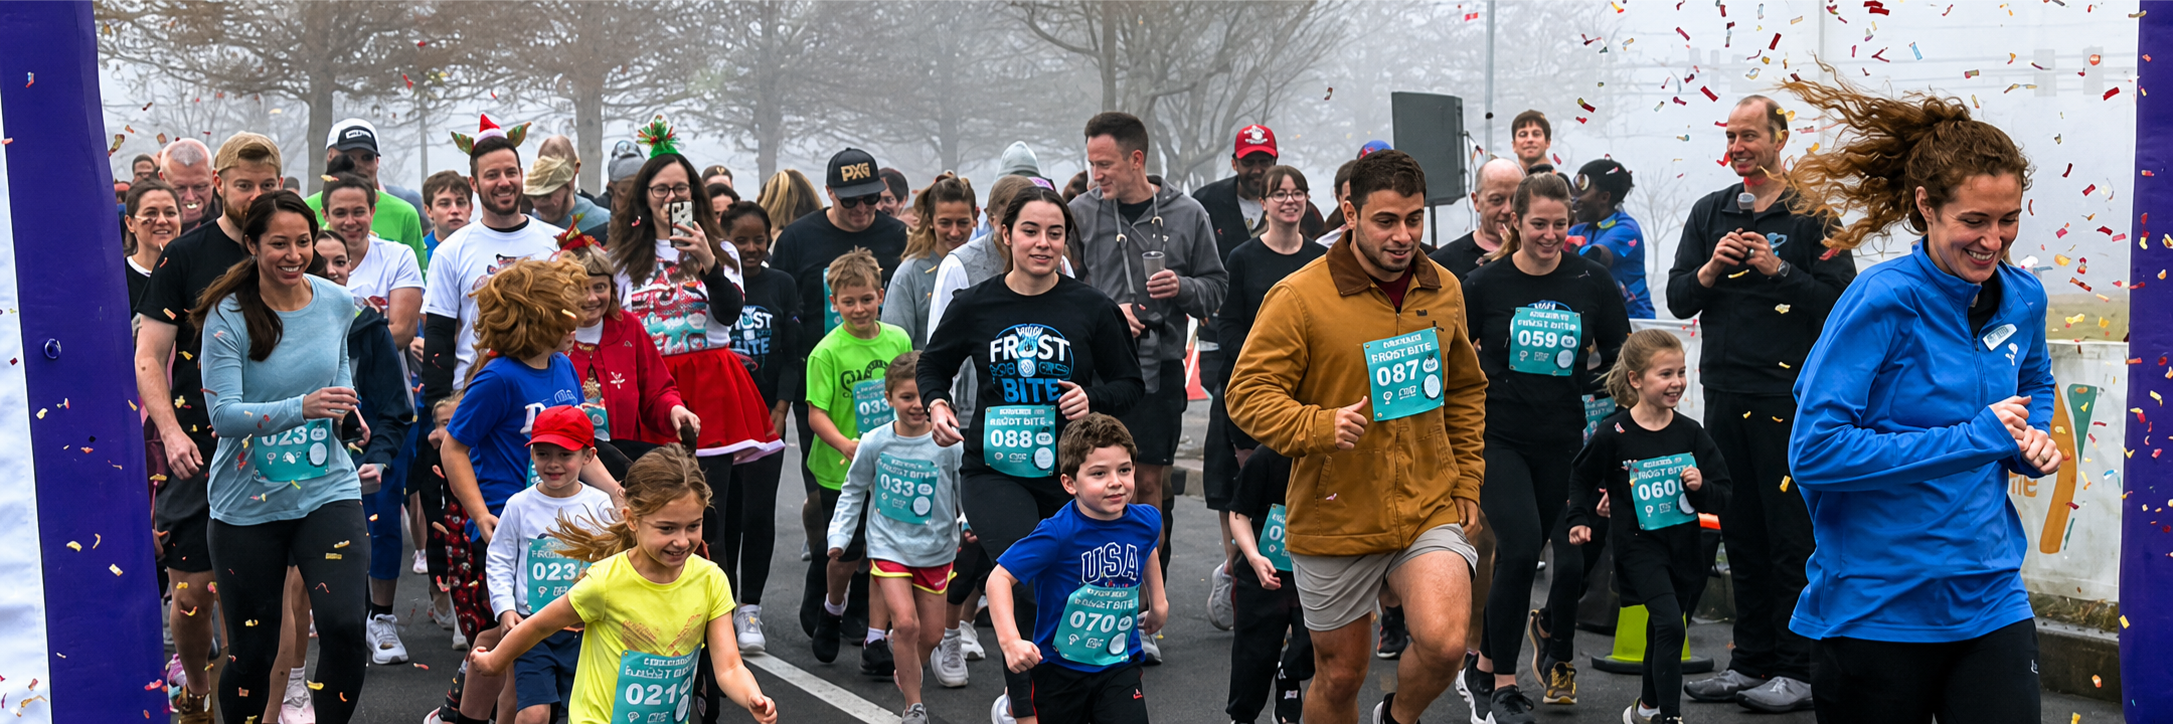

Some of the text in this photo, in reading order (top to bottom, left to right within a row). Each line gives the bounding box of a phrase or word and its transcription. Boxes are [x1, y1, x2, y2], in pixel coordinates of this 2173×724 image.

[840, 162, 871, 182] PXG
[990, 333, 1070, 363] FROST
[1518, 330, 1558, 348] 059
[1376, 359, 1419, 387] 087
[1001, 378, 1062, 403] BITE
[859, 397, 890, 415] 033
[261, 426, 307, 446] 023
[990, 429, 1033, 449] 088
[880, 473, 915, 497] 033
[1638, 479, 1676, 501] 060
[532, 562, 577, 581] 023
[1081, 542, 1139, 584] USA
[1069, 610, 1116, 633] 070
[625, 683, 678, 705] 021
